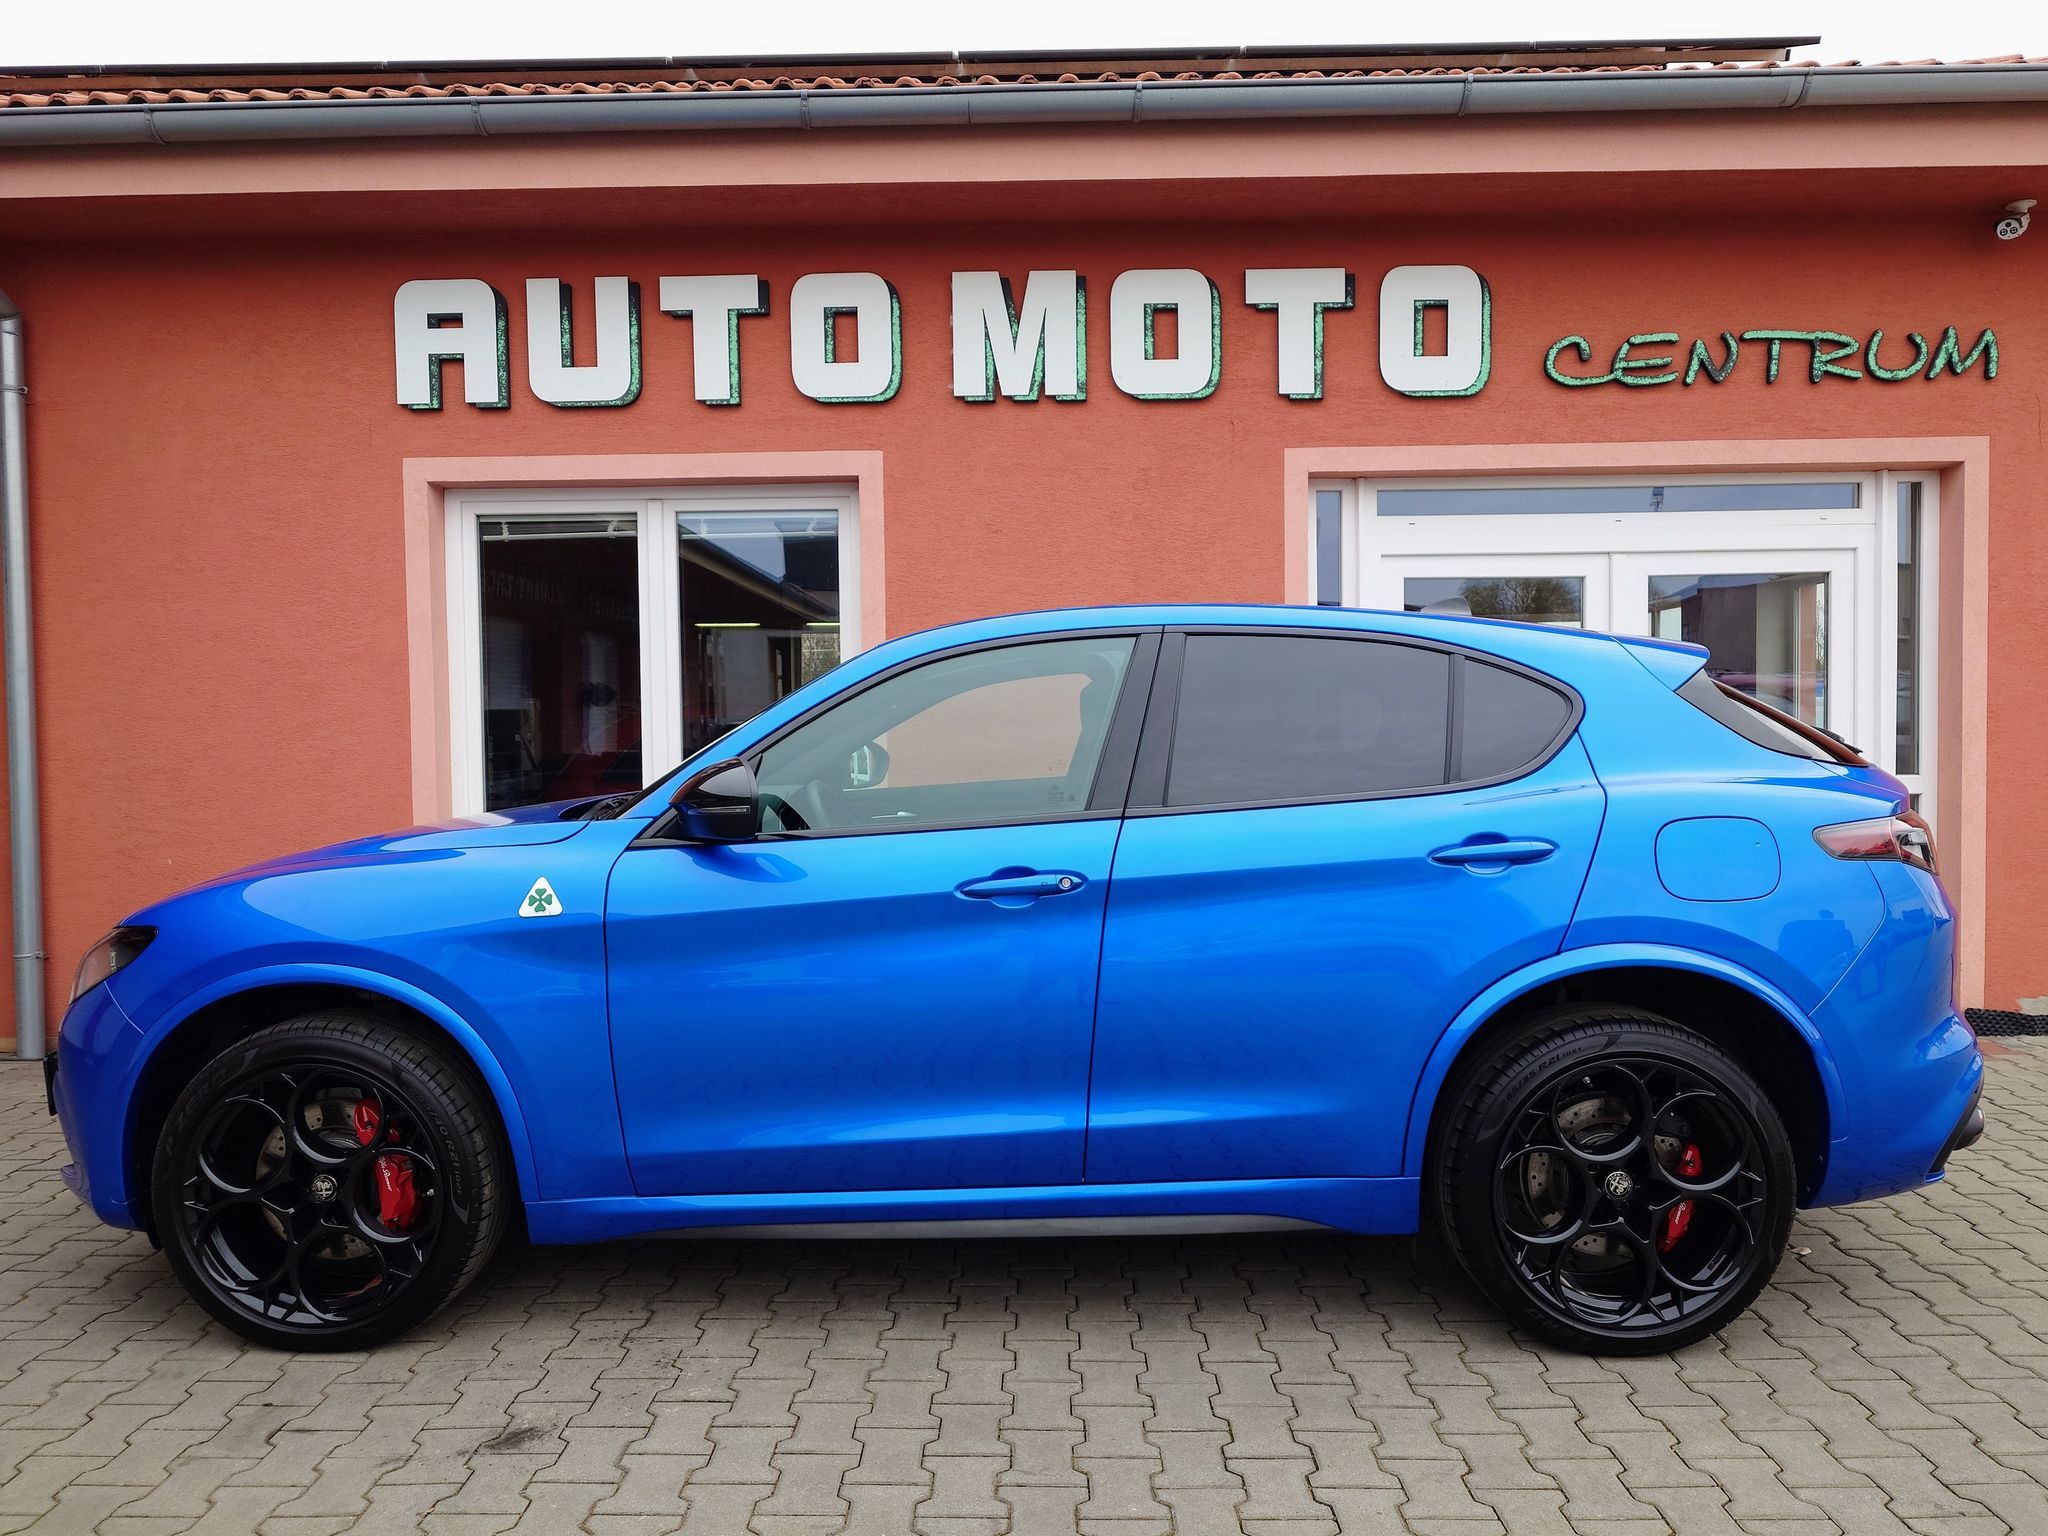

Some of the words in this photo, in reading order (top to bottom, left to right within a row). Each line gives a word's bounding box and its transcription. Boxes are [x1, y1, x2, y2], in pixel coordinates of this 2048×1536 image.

[393, 271, 902, 411] AUTO
[951, 265, 1492, 402] MOTO
[1543, 325, 1999, 387] CENTRUM
